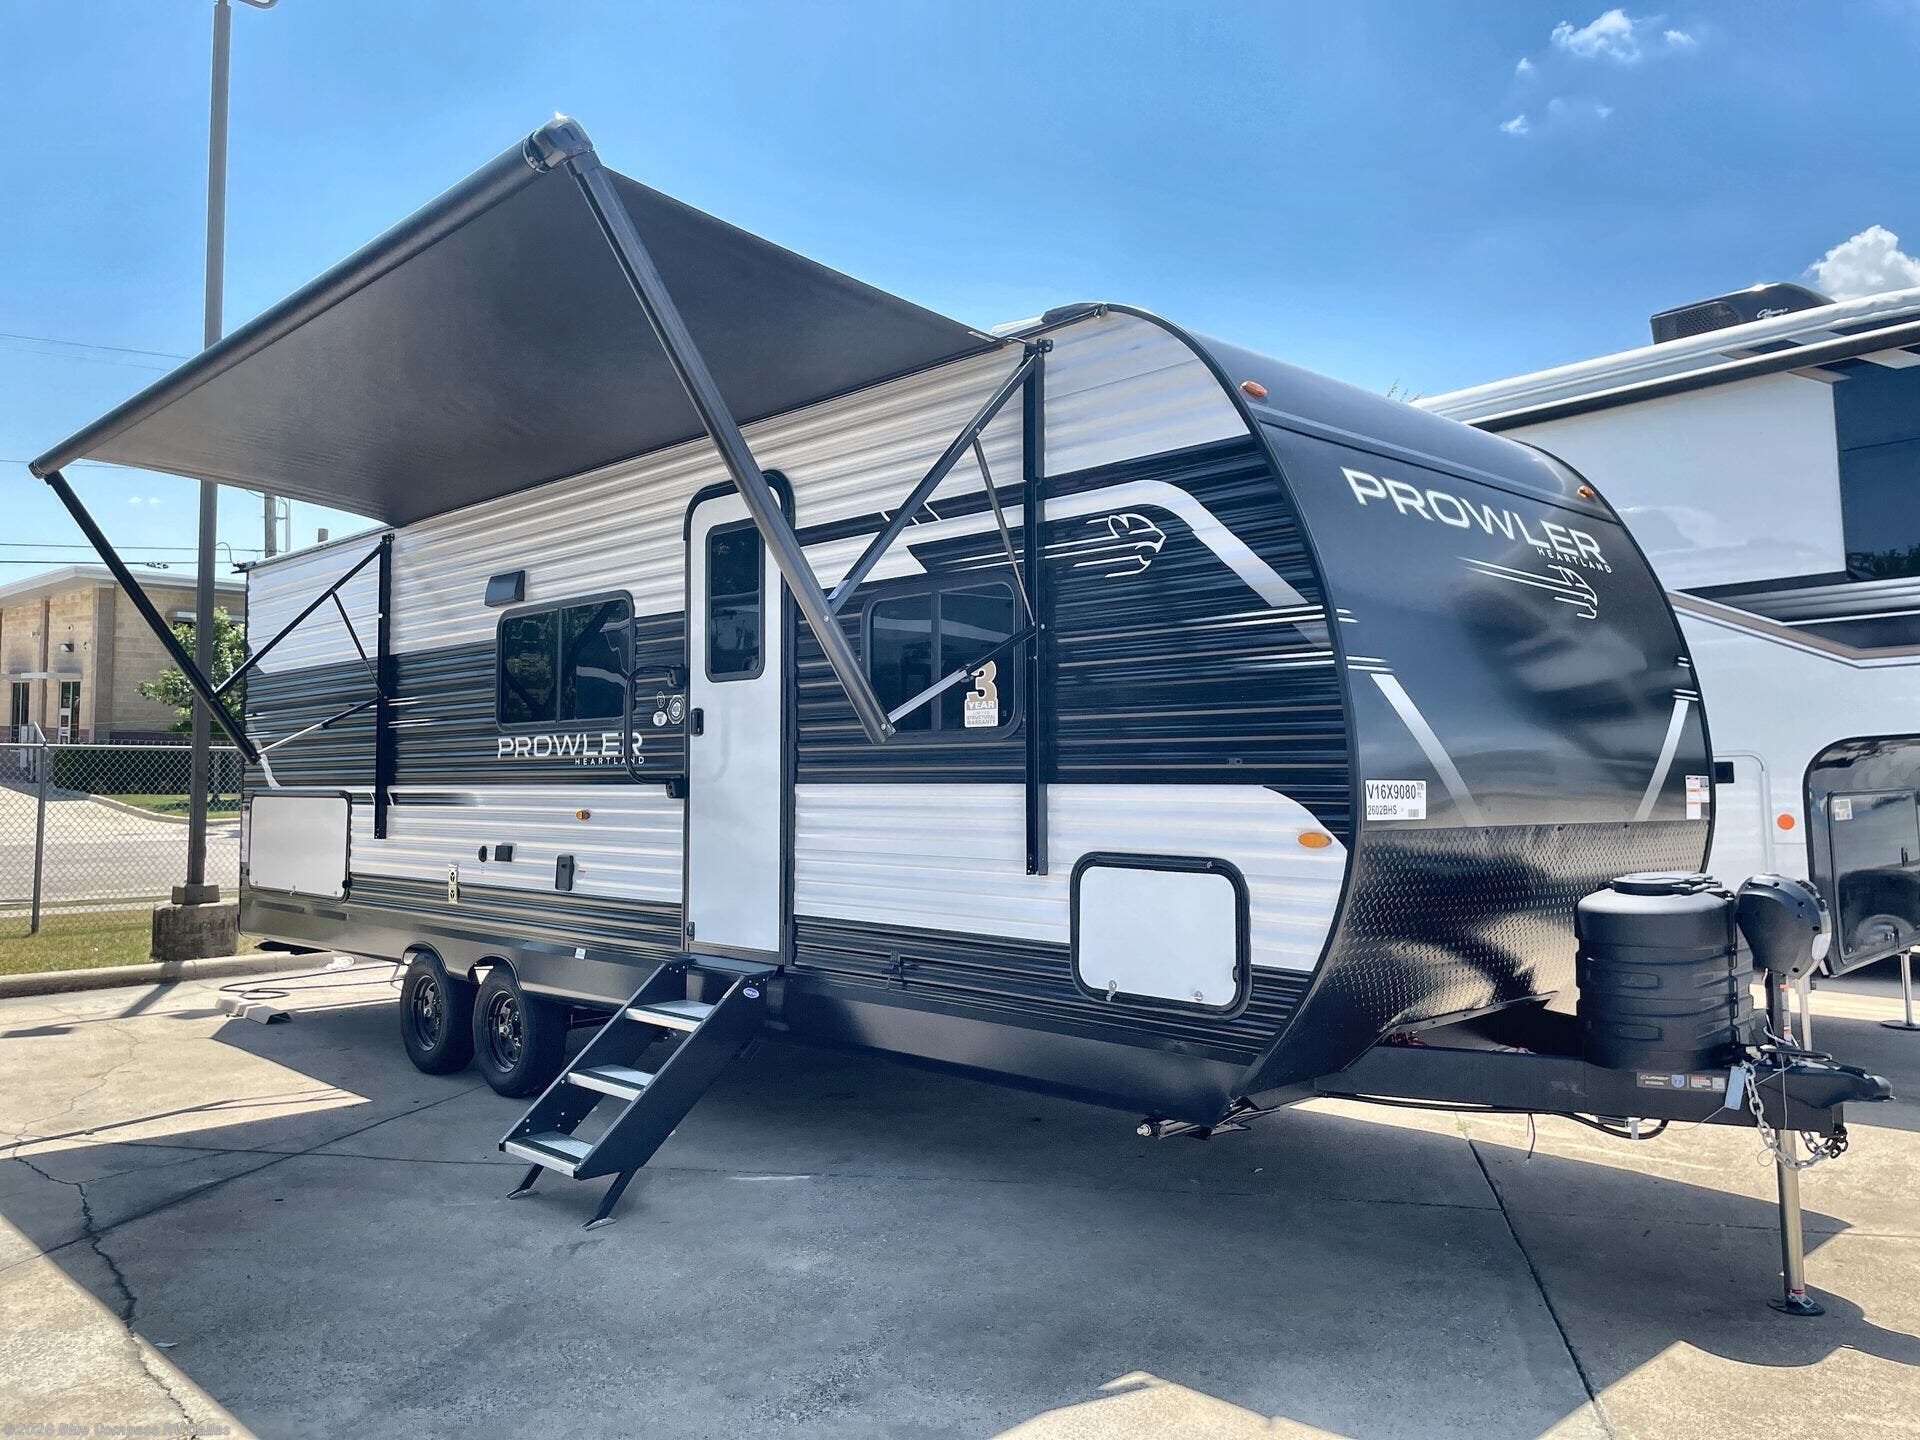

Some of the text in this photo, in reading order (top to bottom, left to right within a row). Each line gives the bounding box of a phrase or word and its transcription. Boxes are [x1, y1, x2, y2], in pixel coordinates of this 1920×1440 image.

[1340, 466, 1606, 563] PROWLER
[1537, 546, 1612, 574] HEARTLAND
[966, 660, 998, 701] 3
[968, 701, 995, 709] YEAR
[497, 731, 643, 759] PROWLER
[574, 756, 645, 766] HEARTLAND
[1366, 783, 1417, 800] V16X9080
[1367, 804, 1398, 816] 2602BHS
